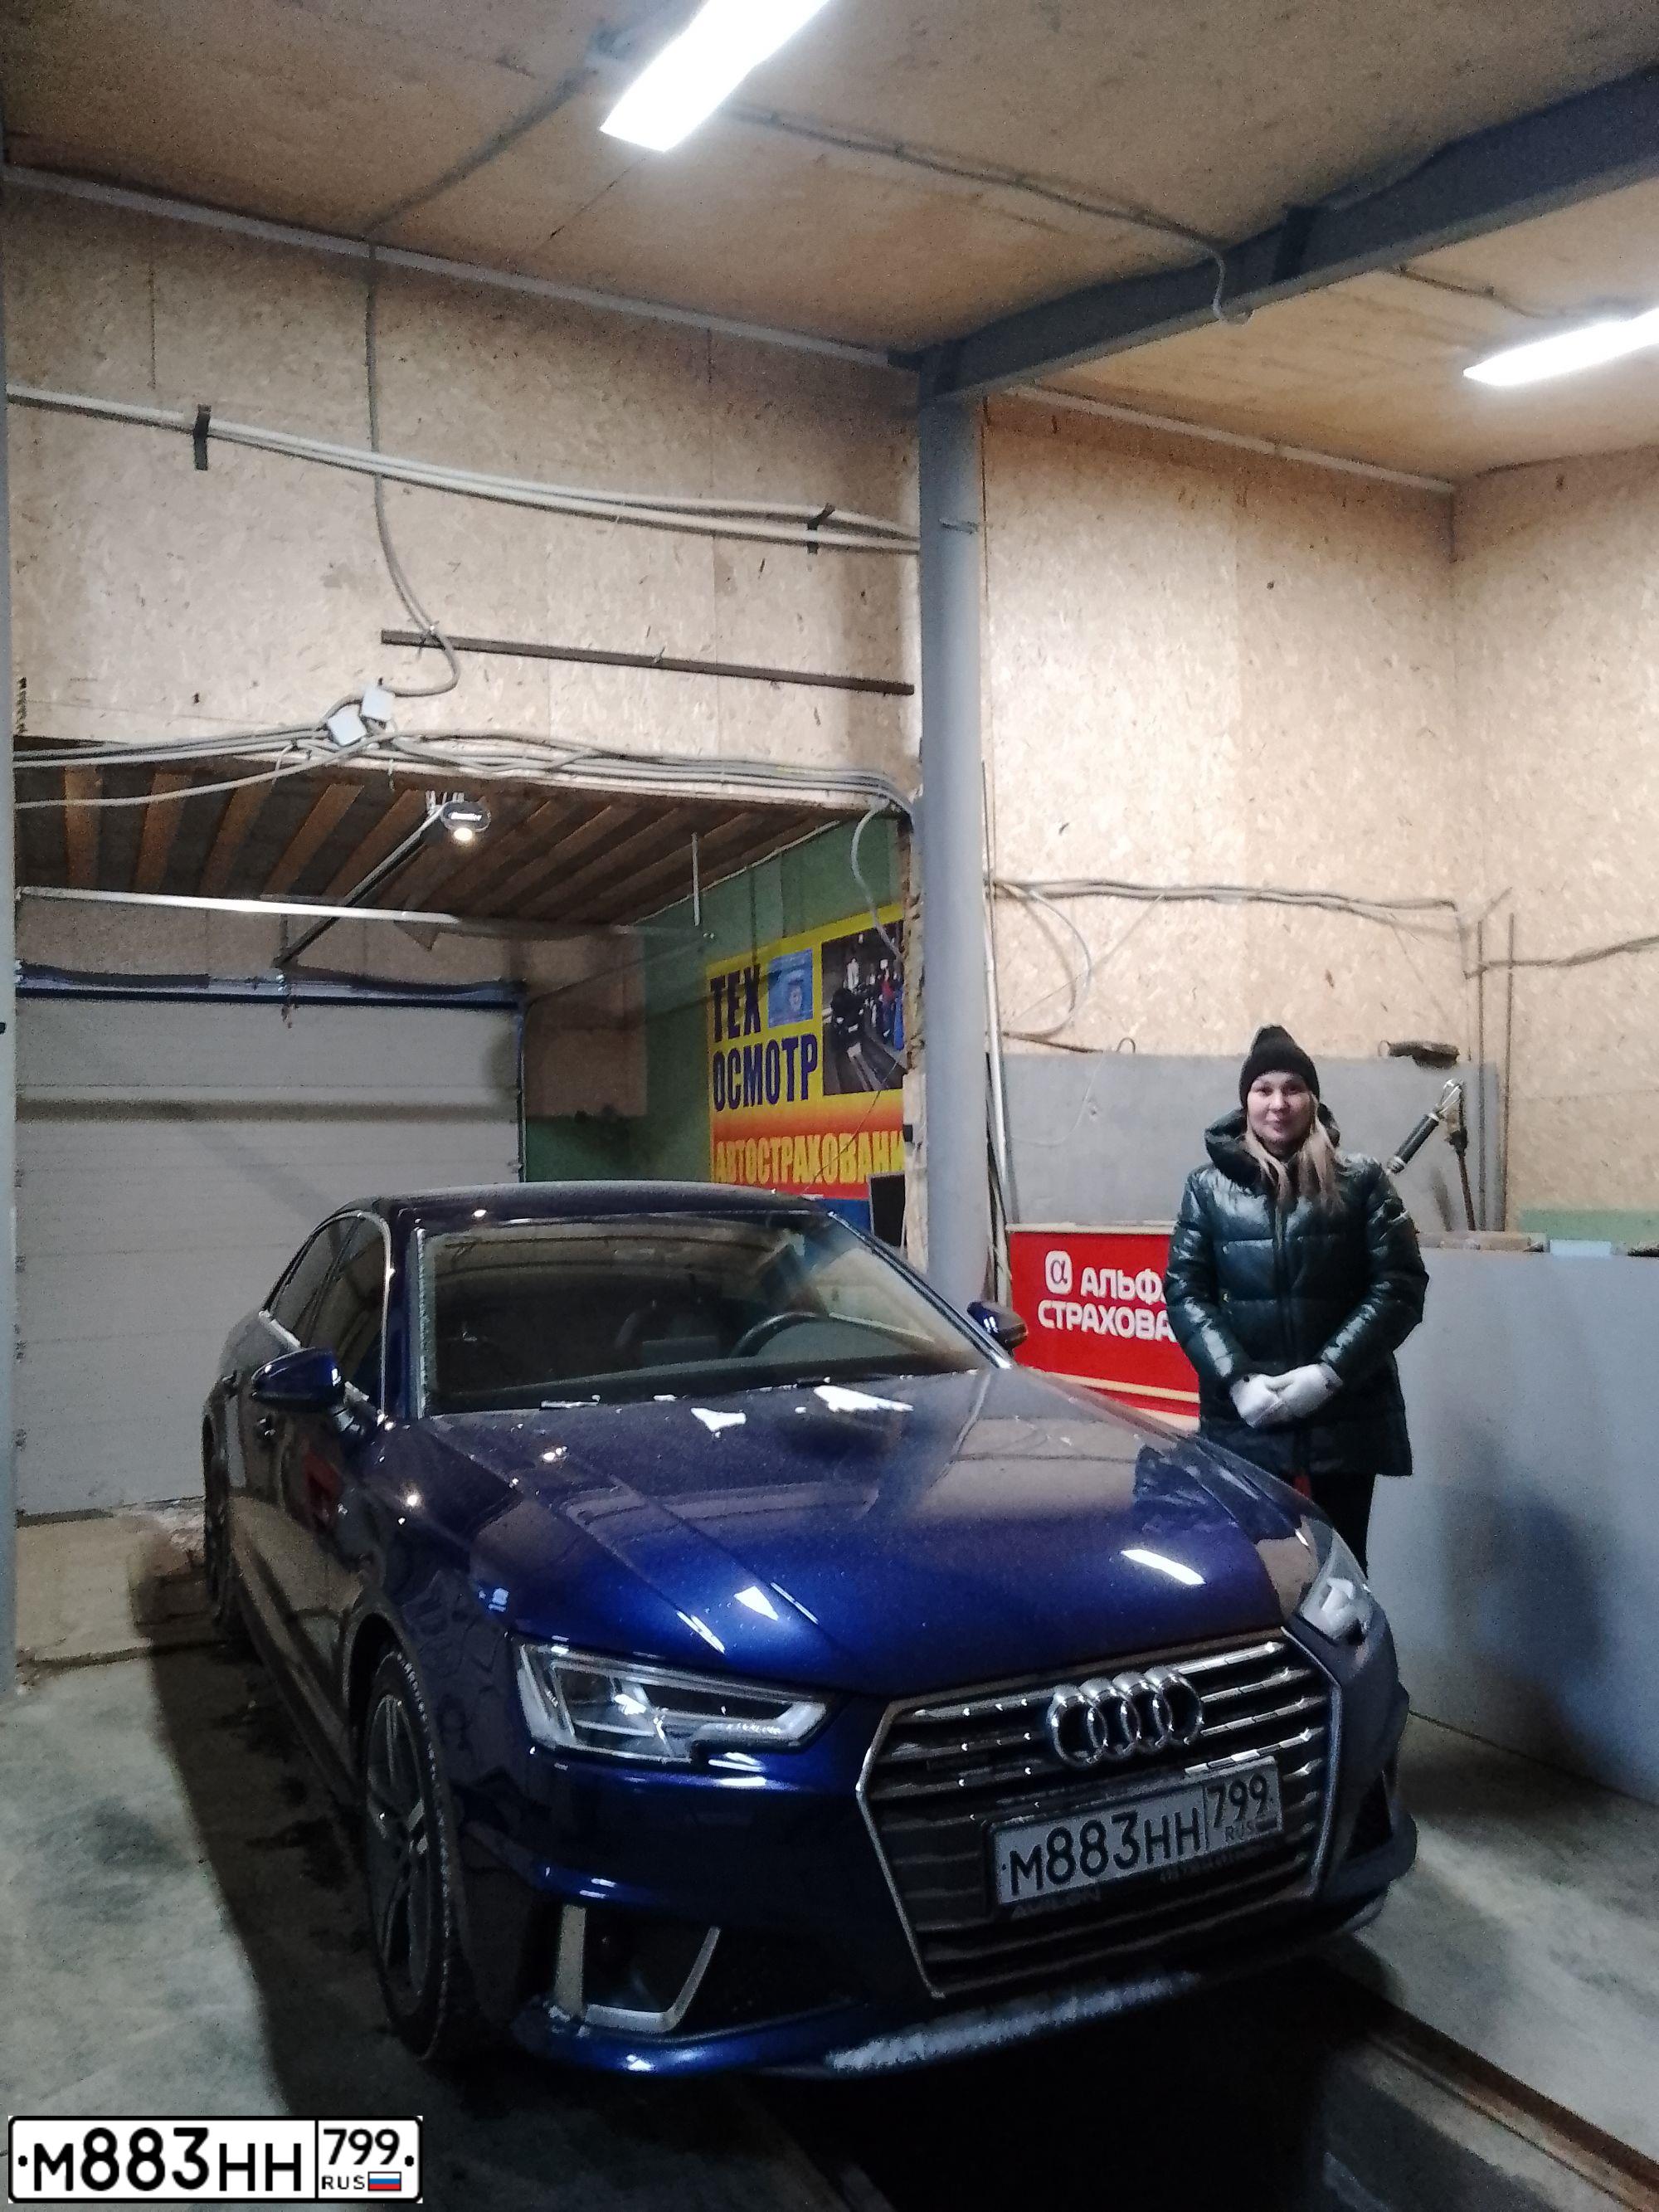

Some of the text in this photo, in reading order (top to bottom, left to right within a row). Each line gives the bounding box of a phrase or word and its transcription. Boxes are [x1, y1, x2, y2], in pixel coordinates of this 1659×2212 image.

[709, 963, 761, 1043] ТЕХ
[712, 1033, 819, 1112] ОСМОТР
[1080, 1267, 1167, 1306] АЛЬФ
